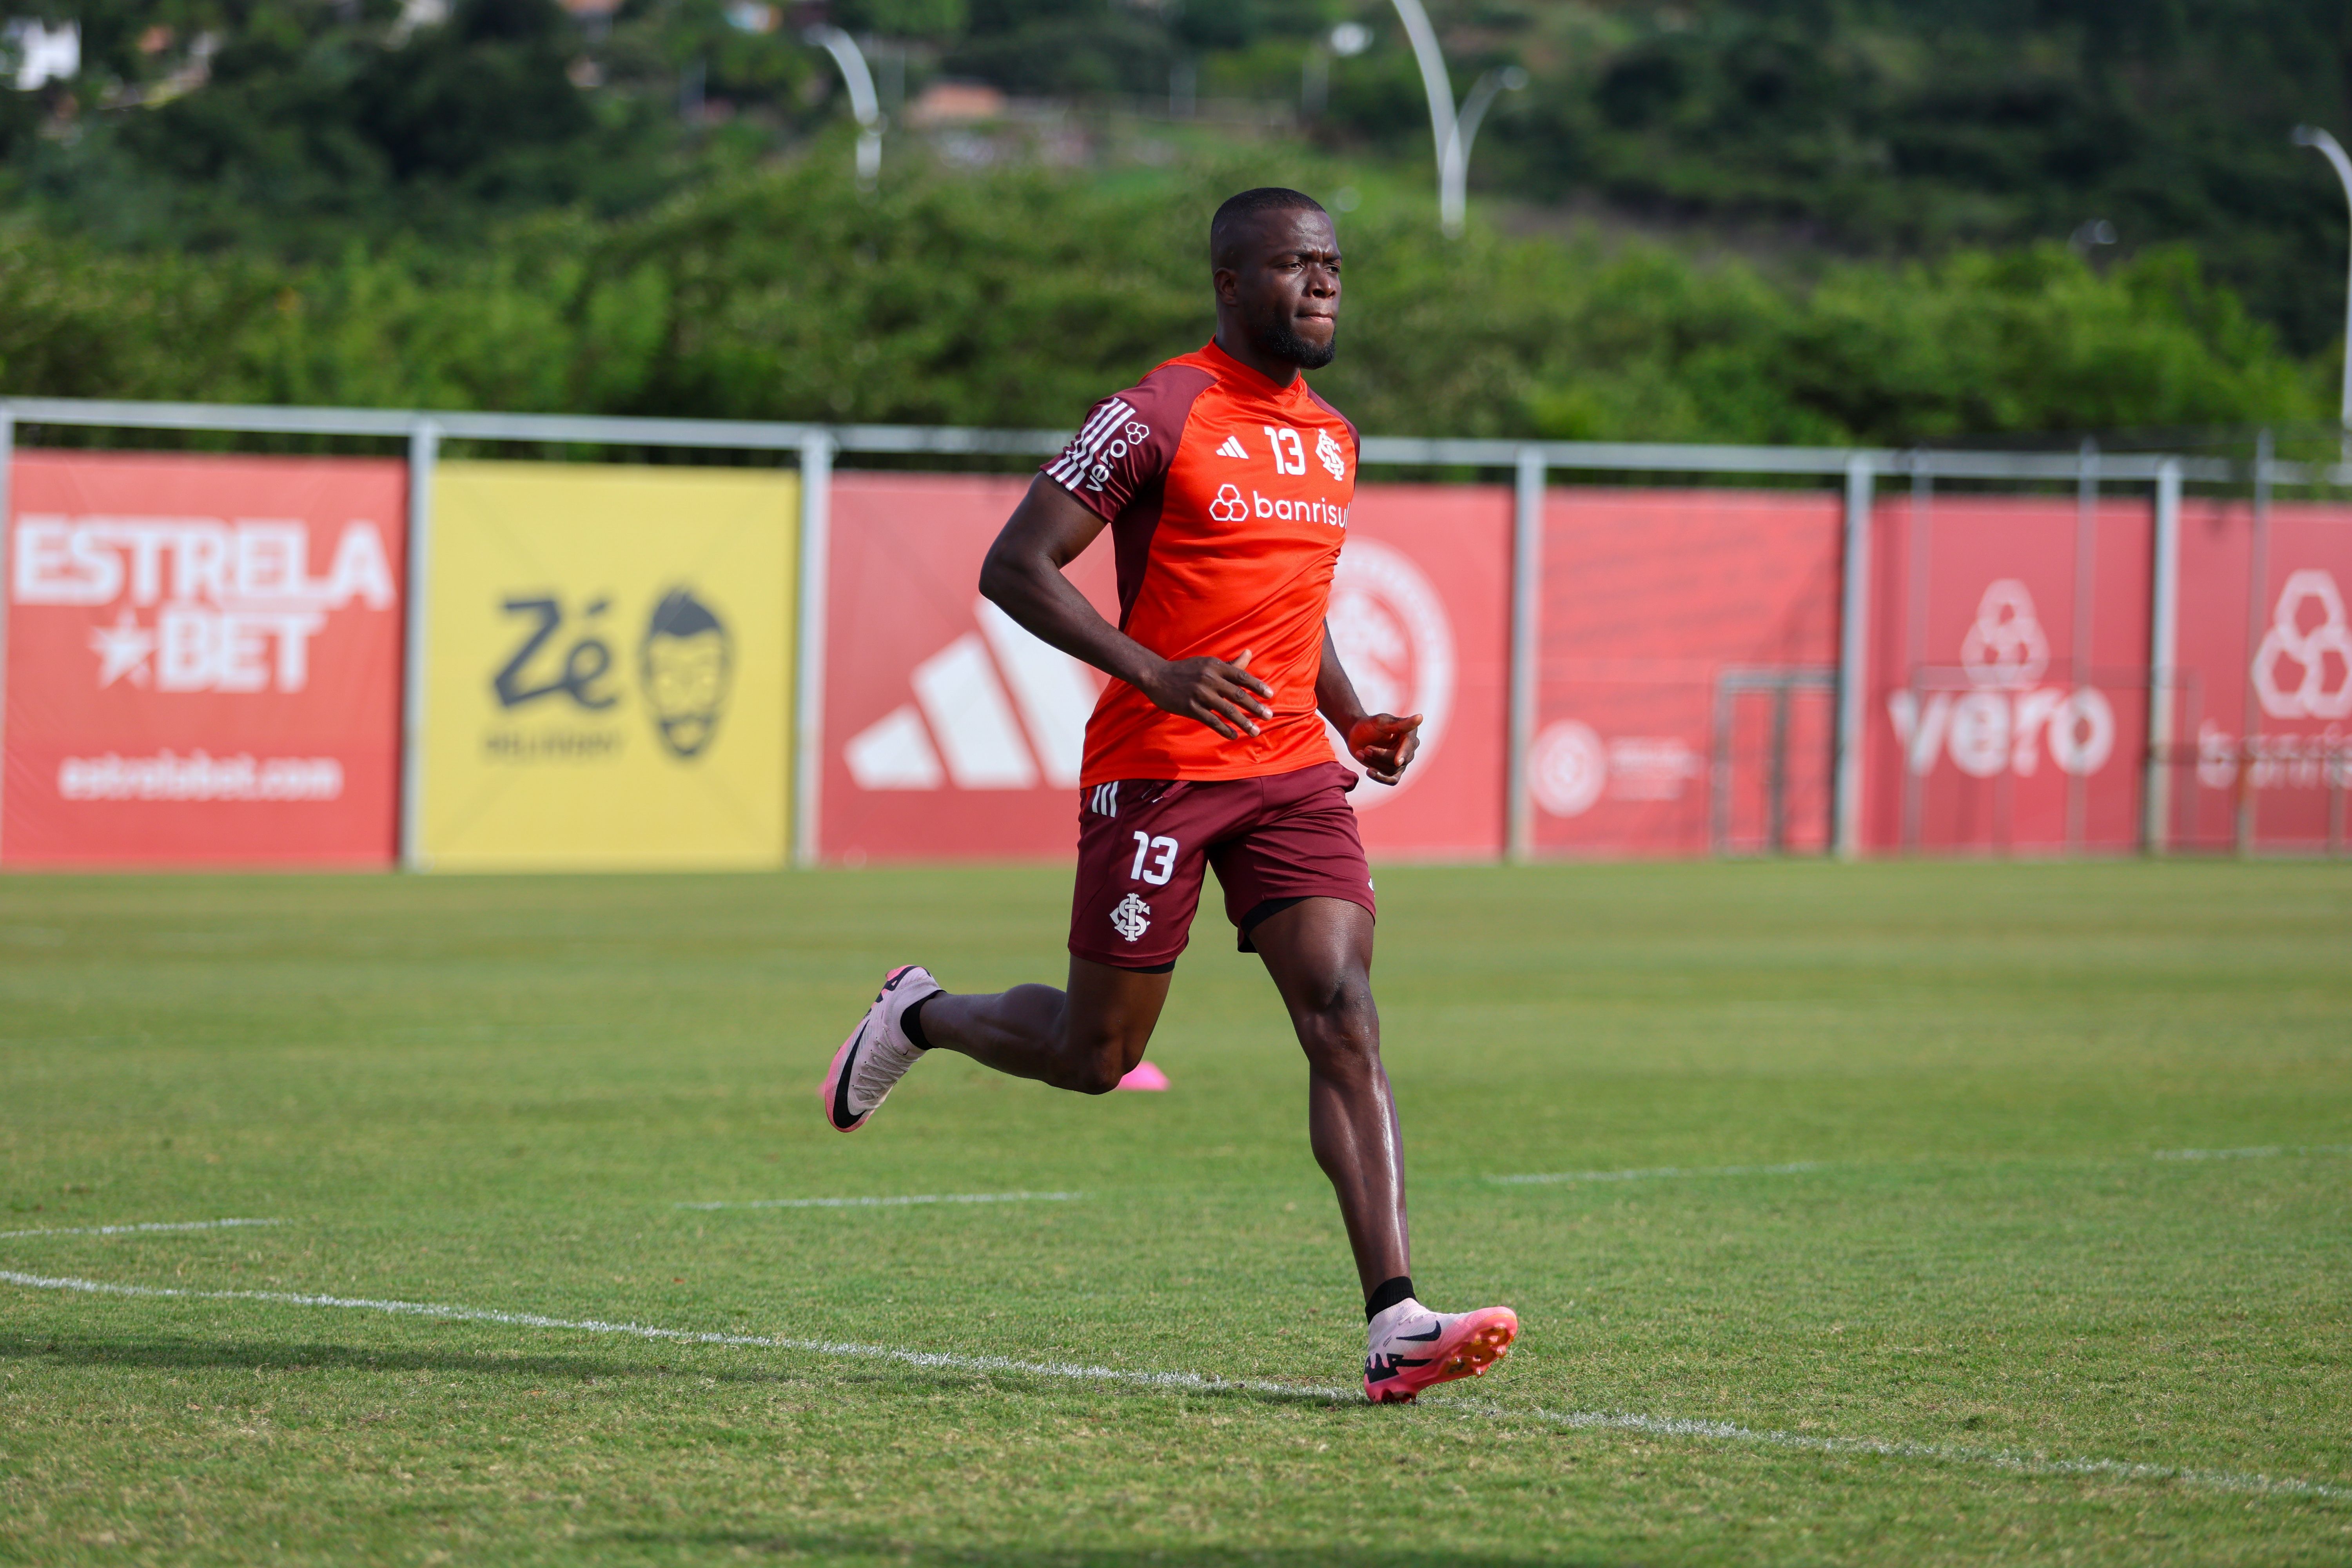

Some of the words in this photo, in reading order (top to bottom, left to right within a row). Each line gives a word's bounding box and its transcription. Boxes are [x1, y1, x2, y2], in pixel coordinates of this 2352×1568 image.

[1086, 439, 1127, 491] vero
[1264, 426, 1305, 475] 13
[1253, 490, 1350, 530] banrisul
[15, 515, 394, 610] ESTRELA
[158, 608, 328, 693] BET
[495, 597, 619, 710] Zé
[1887, 686, 2115, 777] vero
[58, 750, 343, 800] estrelabet.com
[1130, 831, 1178, 885] 13
